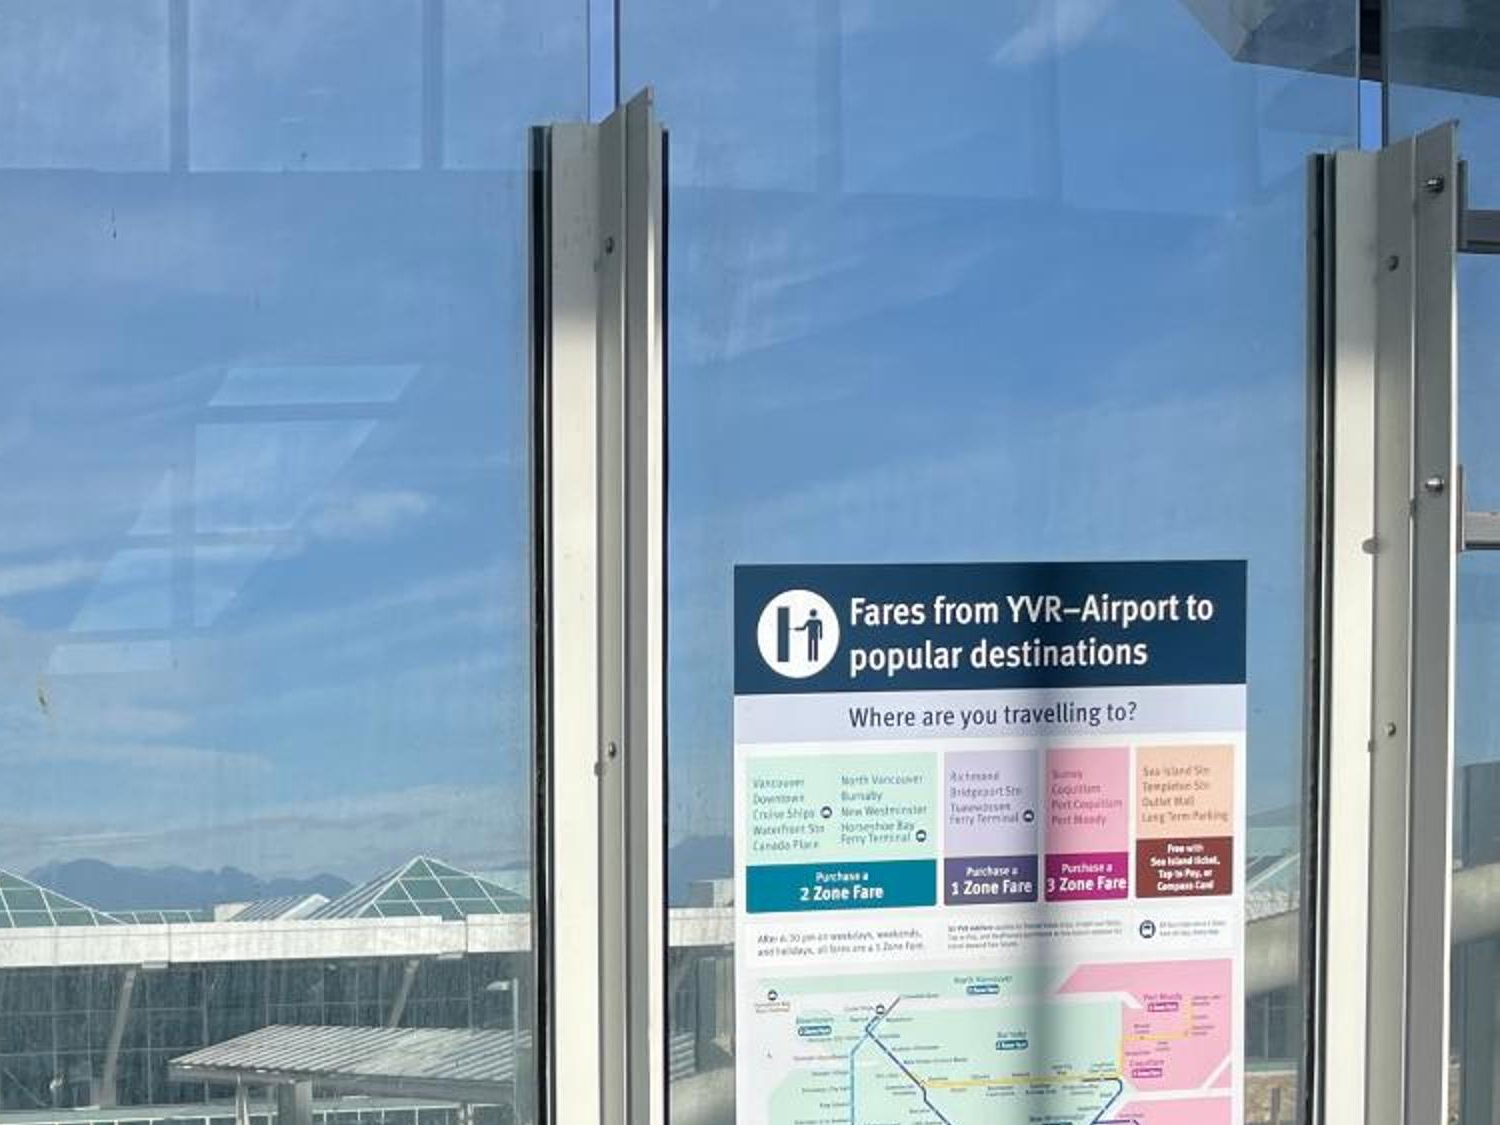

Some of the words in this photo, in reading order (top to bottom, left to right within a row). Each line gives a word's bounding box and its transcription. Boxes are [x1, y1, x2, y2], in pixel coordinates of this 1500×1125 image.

[851, 597, 925, 625] Fares
[934, 595, 998, 624] from
[1187, 596, 1213, 621] to
[850, 641, 962, 677] popular
[971, 638, 1148, 669] destinations
[849, 706, 915, 728] Where
[923, 711, 955, 727] are
[960, 709, 997, 731] you
[1004, 703, 1101, 727] travelling
[1107, 702, 1137, 723] to?
[801, 888, 811, 901] 2
[813, 886, 849, 900] Zone
[853, 885, 884, 899] Fare
[951, 881, 959, 895] 1
[963, 880, 999, 895] Zone
[1003, 879, 1033, 893] Fare
[1047, 879, 1056, 892] 3
[1060, 877, 1094, 891] Zone
[1097, 876, 1127, 890] Fare
